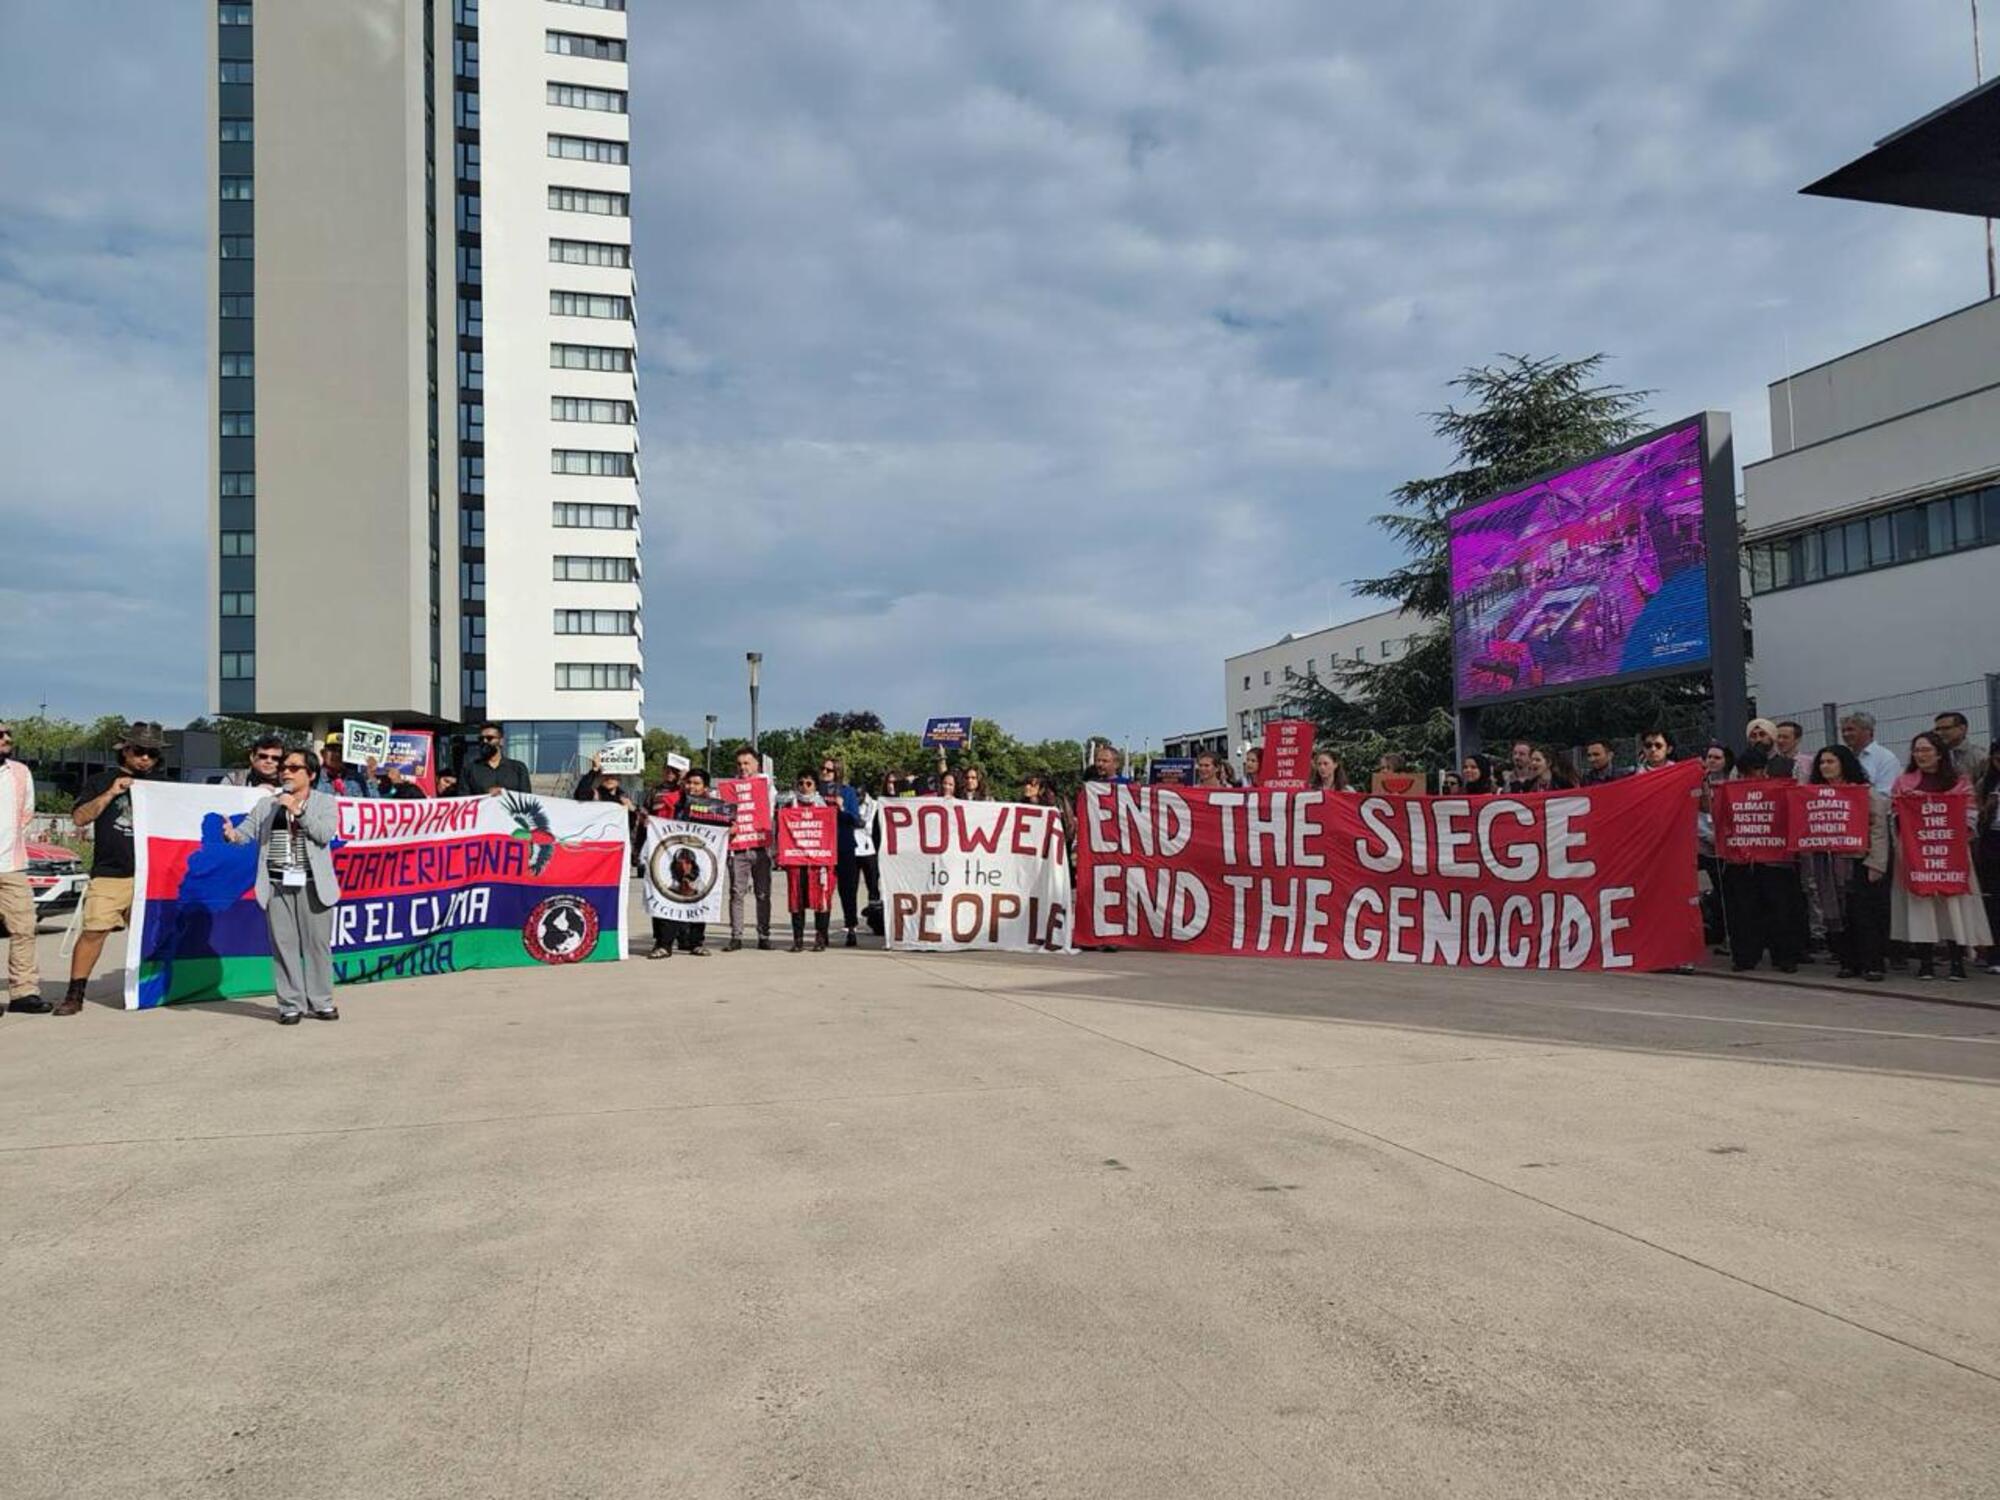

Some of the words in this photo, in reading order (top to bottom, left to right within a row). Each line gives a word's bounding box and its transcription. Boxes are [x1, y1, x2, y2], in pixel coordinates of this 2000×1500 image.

[1747, 791, 1763, 800] NO
[1819, 788, 1835, 797] NO
[1731, 801, 1776, 811] CLIMATE
[1806, 800, 1851, 810] CLIMATE
[1921, 803, 1948, 814] END
[337, 799, 481, 841] CARAVANA
[1733, 813, 1775, 822] JUSTICE
[1808, 811, 1850, 821] JUSTICE
[1922, 816, 1948, 827] THE
[1085, 781, 1193, 857] END
[1208, 790, 1326, 867] THE
[1355, 796, 1597, 881] SIEGE
[1736, 824, 1771, 834] UNDER
[1810, 823, 1846, 833] UNDER
[883, 804, 1067, 866] POWER
[1798, 836, 1862, 847] OCCUPATION
[1921, 845, 1949, 856] END
[334, 840, 524, 892] SOAMERICANA
[1922, 859, 1948, 869] THE
[931, 862, 949, 886] to
[965, 859, 1002, 886] the
[364, 902, 404, 943] EL
[893, 893, 1067, 950] PEOPLE
[1093, 865, 1210, 941] END
[1223, 875, 1333, 953] THE
[1343, 885, 1635, 969] GENOCIDE
